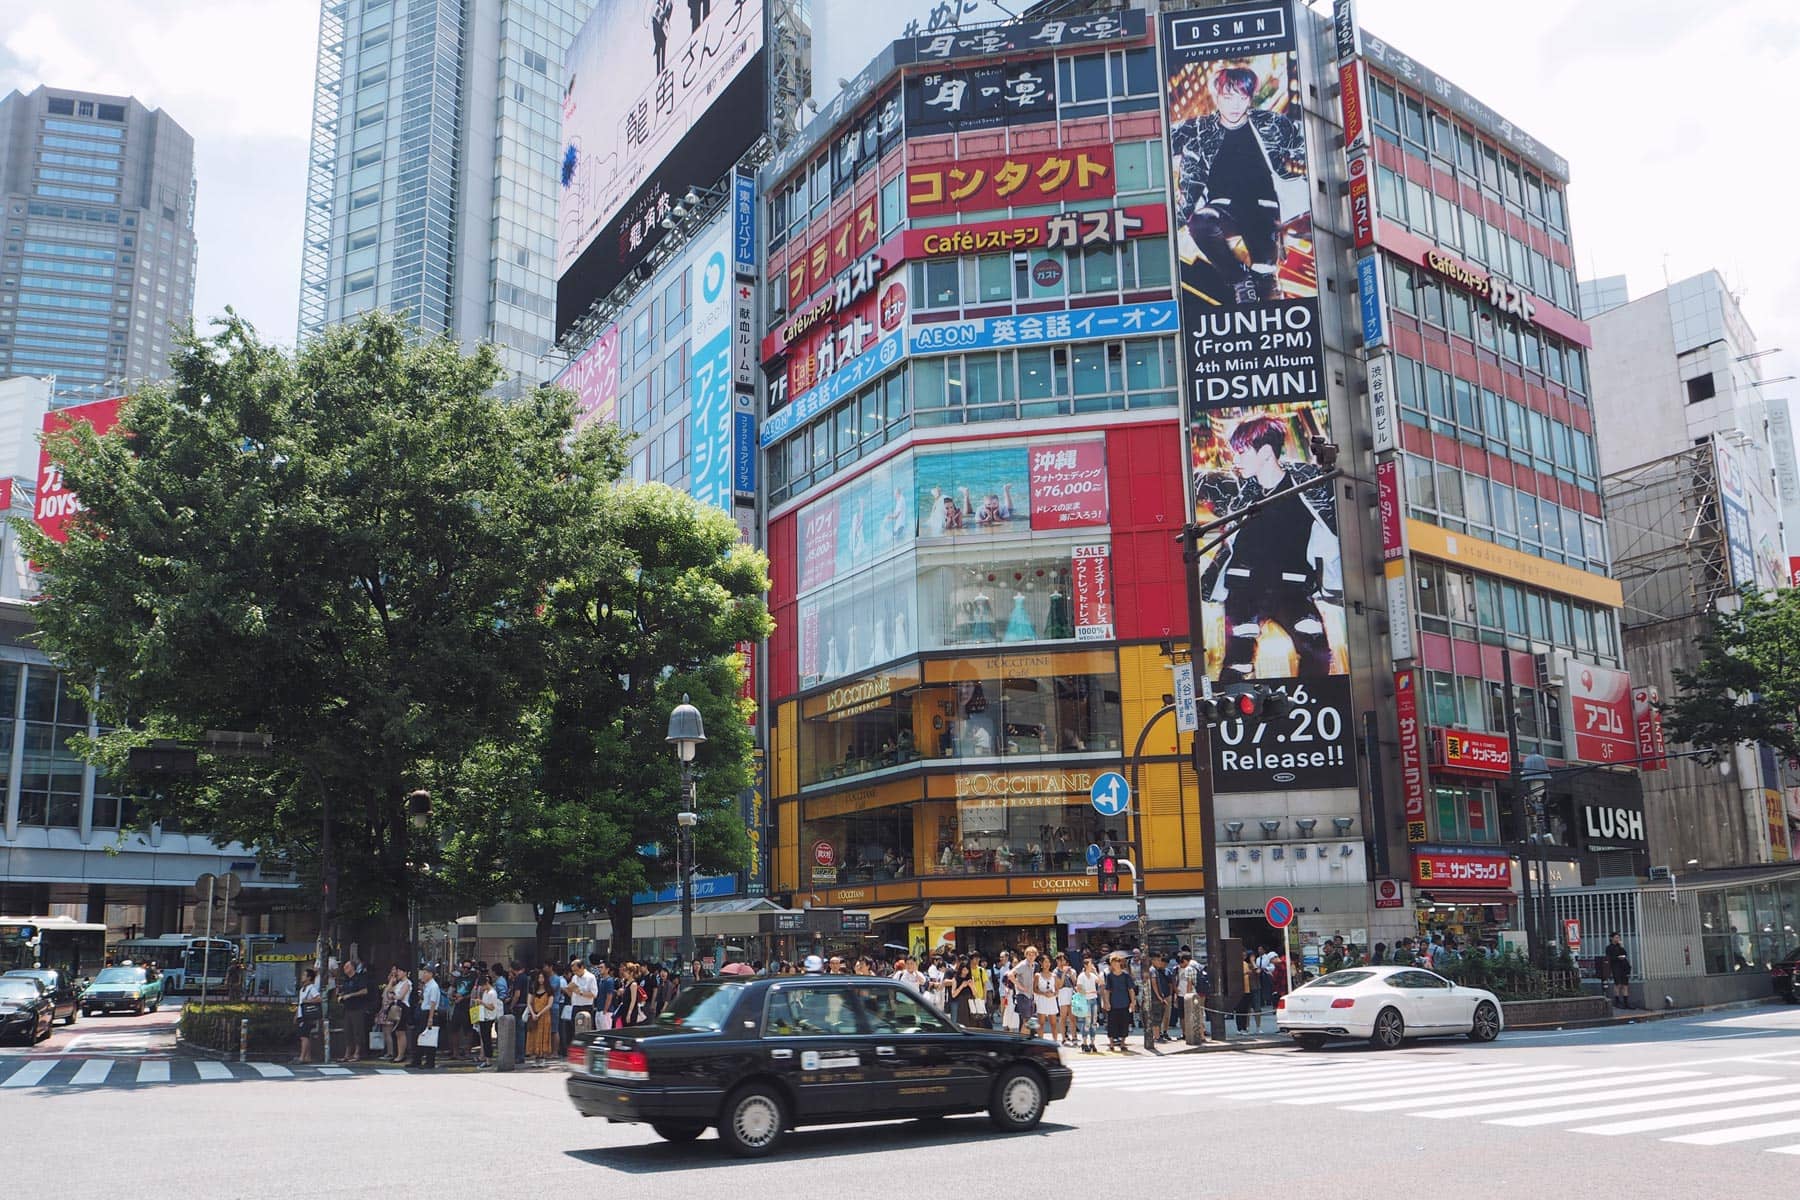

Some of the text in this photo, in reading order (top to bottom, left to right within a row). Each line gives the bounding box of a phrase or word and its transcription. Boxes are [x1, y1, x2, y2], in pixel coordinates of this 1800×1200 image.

[1191, 18, 1265, 40] DSMN
[924, 75, 942, 87] 9F
[1434, 77, 1452, 99] 9F
[909, 153, 1108, 205] コンタクト
[739, 190, 751, 260] 東急リバブル
[1047, 211, 1143, 250] ガスト
[1355, 195, 1369, 239] ガスト
[790, 203, 877, 299] プライス
[834, 253, 882, 314] ガスト
[1490, 276, 1537, 322] ガスト
[916, 307, 1172, 350] AEON 英会話イーオン
[1192, 305, 1312, 338] JUNHO
[739, 308, 751, 371] 献血ルーム
[816, 316, 873, 385] ガスト
[1194, 330, 1313, 358] (From 2PM)
[1195, 353, 1315, 374] 4th Mini Album
[769, 373, 788, 406] 7F
[795, 356, 876, 421] 英会話イーオン
[1371, 366, 1387, 444] 渋谷駅前ビル
[1033, 449, 1078, 472] 沖縄
[1377, 461, 1394, 476] 5F
[1075, 546, 1105, 557] SALE
[1076, 558, 1090, 626] アウトレットドレス
[1583, 703, 1625, 735] アコム
[1600, 743, 1615, 759] 3F
[1639, 721, 1654, 754] アコム
[1221, 744, 1345, 772] Release!!
[1399, 717, 1423, 815] サンドラッグ
[1472, 747, 1508, 764] サンドラッグ
[1585, 805, 1645, 841] LUSH
[1225, 844, 1353, 863] 渋谷駅前ビル
[1450, 862, 1497, 880] サンドラッグ
